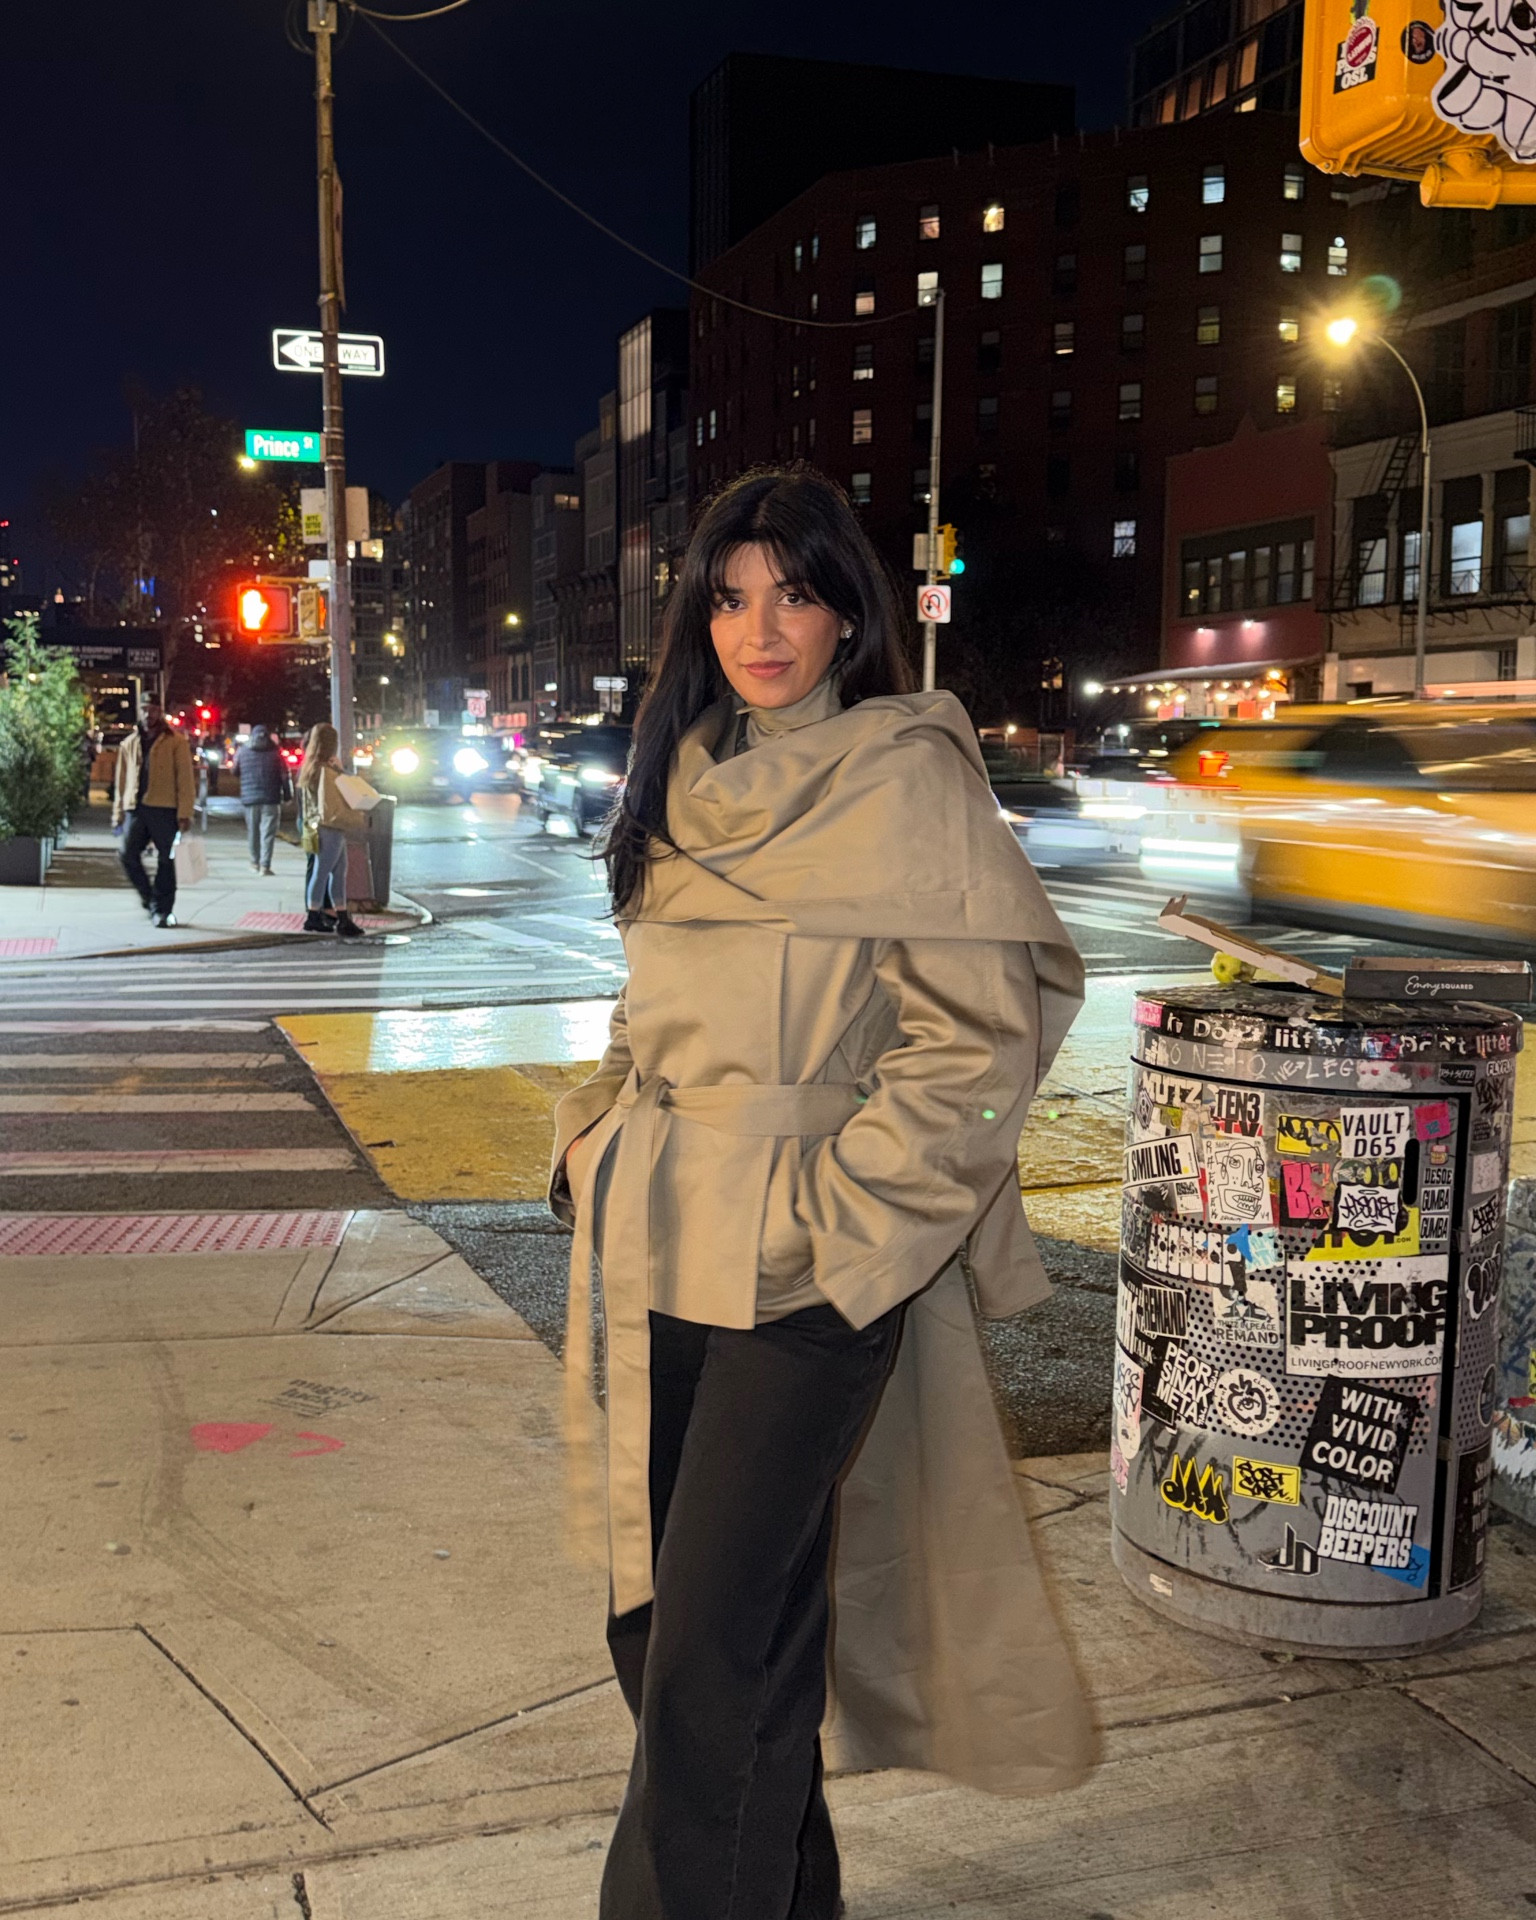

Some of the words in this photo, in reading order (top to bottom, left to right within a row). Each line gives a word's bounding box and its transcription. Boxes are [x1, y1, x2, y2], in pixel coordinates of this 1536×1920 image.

[1341, 66, 1369, 89] OSL
[294, 344, 322, 359] ONE
[342, 348, 370, 361] WAY
[253, 434, 300, 457] Prince
[303, 436, 313, 449] St
[1405, 975, 1440, 996] Emmy
[1342, 1112, 1405, 1137] VAULT
[1353, 1136, 1396, 1157] D65
[1131, 1142, 1182, 1182] SMILING
[1421, 1187, 1450, 1213] GUMBA
[1419, 1216, 1448, 1239] GUMBA
[1290, 1279, 1449, 1315] LIVING
[1216, 1328, 1278, 1345] REMAND
[1251, 1322, 1276, 1331] PEACE
[1290, 1311, 1447, 1349] PROOF
[1164, 1341, 1213, 1389] PEOR
[1341, 1386, 1403, 1424] WITH
[1331, 1413, 1398, 1454] VIVID
[1311, 1440, 1395, 1484] COLOR
[1322, 1494, 1418, 1538] DISCOUNT
[1316, 1527, 1413, 1569] BEEPERS
